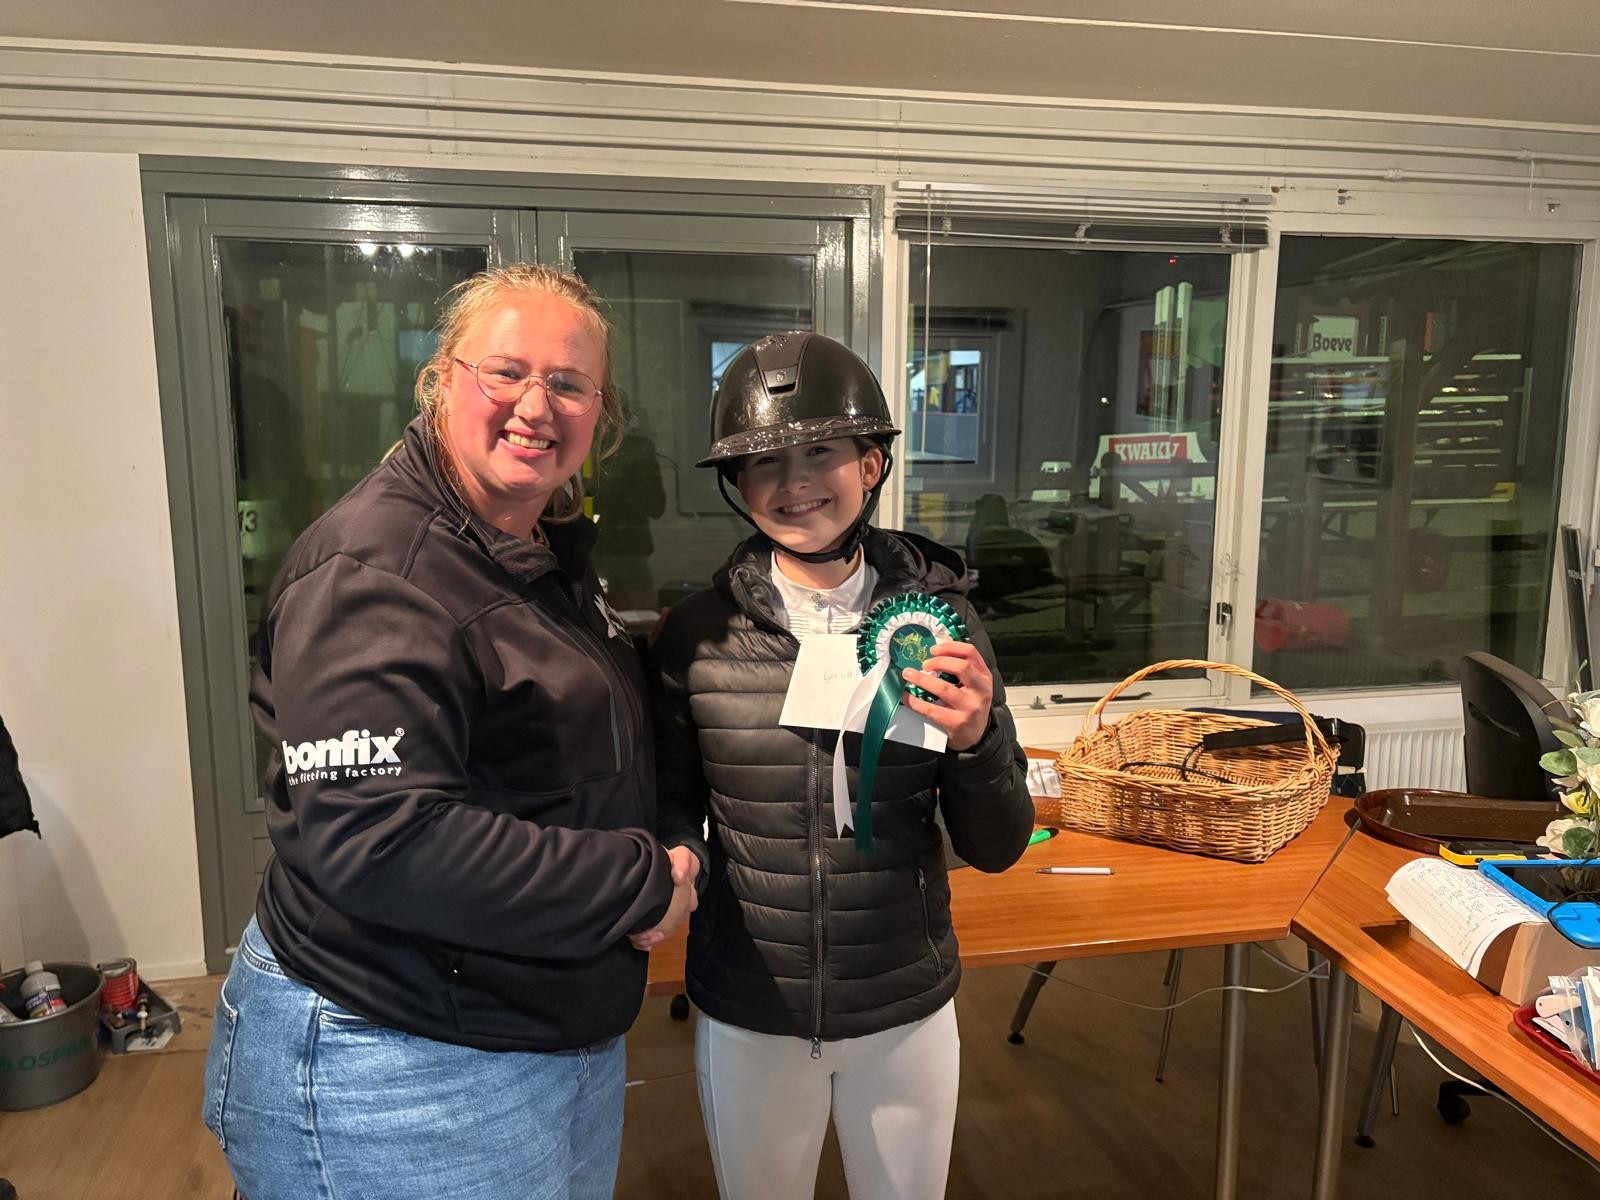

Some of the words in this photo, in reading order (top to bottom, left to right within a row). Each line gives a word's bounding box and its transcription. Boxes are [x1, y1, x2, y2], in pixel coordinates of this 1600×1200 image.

[1313, 332, 1353, 352] Boeve
[299, 769, 338, 782] fitting
[345, 766, 402, 778] factory
